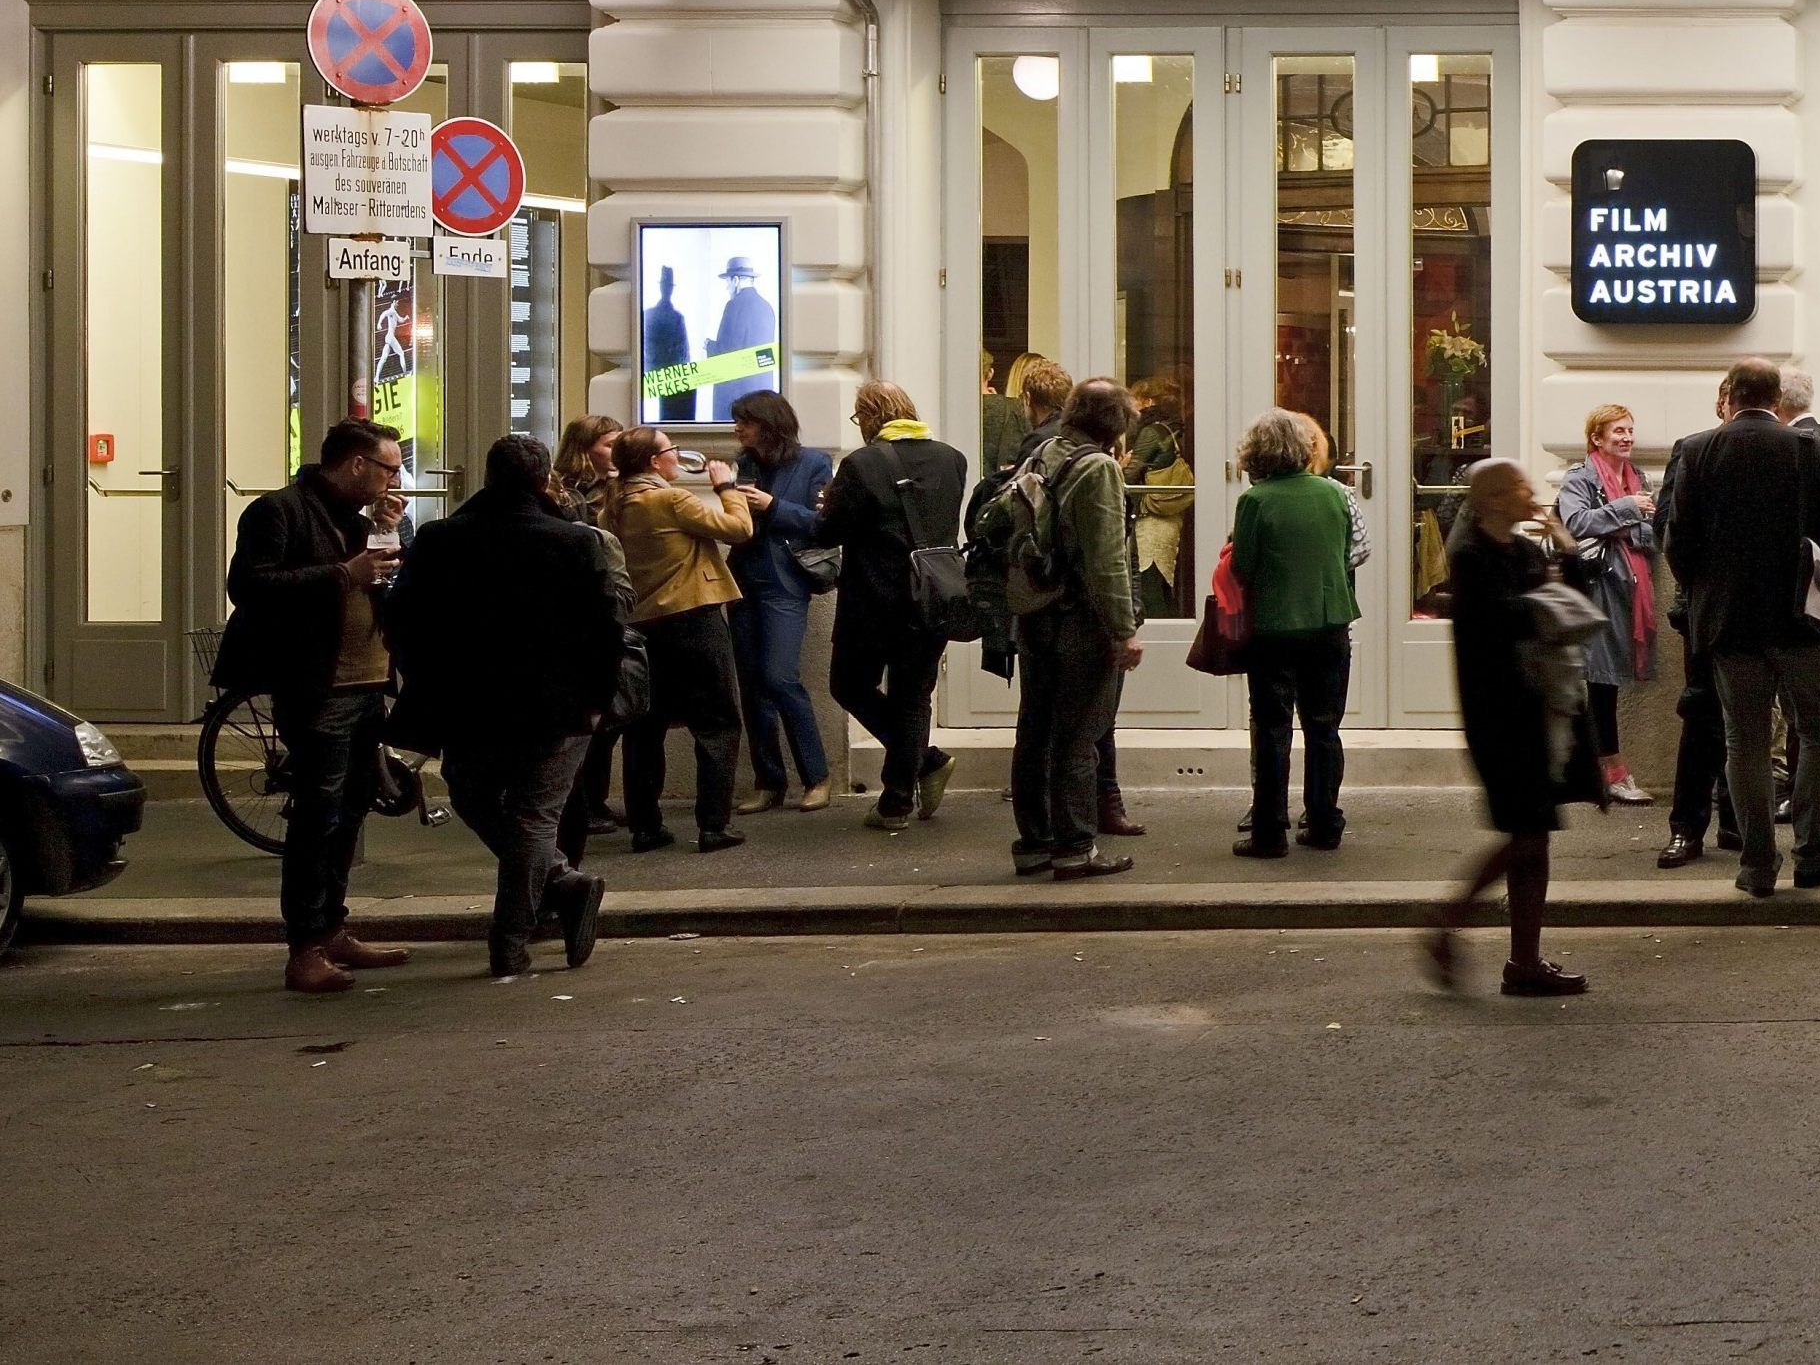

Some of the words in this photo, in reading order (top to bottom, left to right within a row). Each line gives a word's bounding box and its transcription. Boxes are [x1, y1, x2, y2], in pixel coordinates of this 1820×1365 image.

[313, 124, 368, 147] werktags
[341, 149, 380, 172] Fahrzeuge
[388, 151, 428, 173] Botschaft
[335, 173, 352, 191] des
[355, 178, 407, 194] souveränen
[1590, 208, 1667, 232] FILM
[339, 248, 401, 277] Anfang
[449, 245, 493, 265] Ende
[1589, 244, 1718, 268] ARCHIV
[1589, 279, 1737, 304] AUSTRIA
[644, 362, 699, 385] WERNER
[648, 378, 690, 398] NEKES
